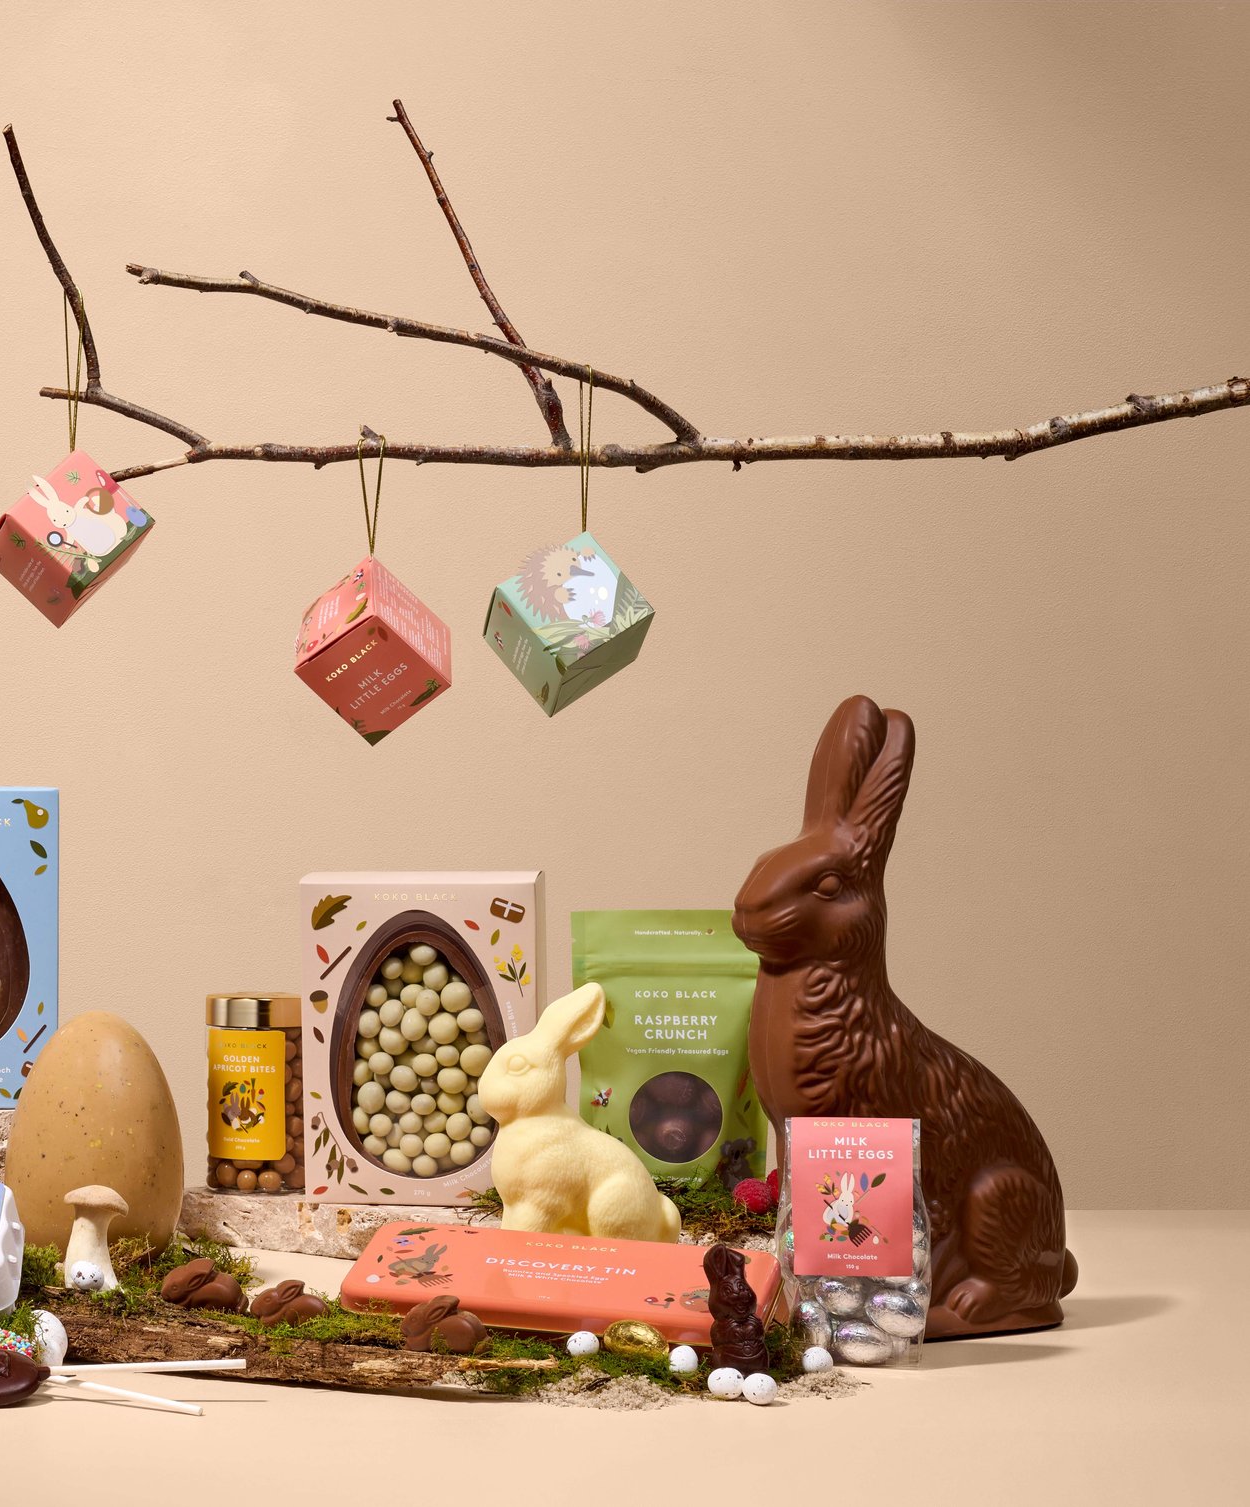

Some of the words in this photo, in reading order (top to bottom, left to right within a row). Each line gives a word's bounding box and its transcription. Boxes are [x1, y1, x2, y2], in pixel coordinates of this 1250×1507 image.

[326, 664, 348, 682] KOKO
[350, 640, 378, 664] BLACK
[358, 668, 382, 690] MILK
[350, 684, 382, 710] LITTLE
[381, 662, 408, 686] EGGS
[374, 893, 408, 901] KOKO
[416, 893, 456, 901] BLACK
[635, 990, 668, 998] KOKO
[676, 990, 716, 998] BLACK
[634, 1015, 718, 1026] RASPBERRY
[644, 1029, 706, 1040] CRUNCH
[223, 1055, 260, 1063] GOLDEN
[213, 1064, 247, 1073] APRICOT
[834, 1136, 867, 1146] MILK
[808, 1149, 852, 1158] LITTLE
[858, 1150, 894, 1159] EGGS
[486, 1257, 596, 1272] DISCOVERY
[605, 1266, 637, 1276] TIN
